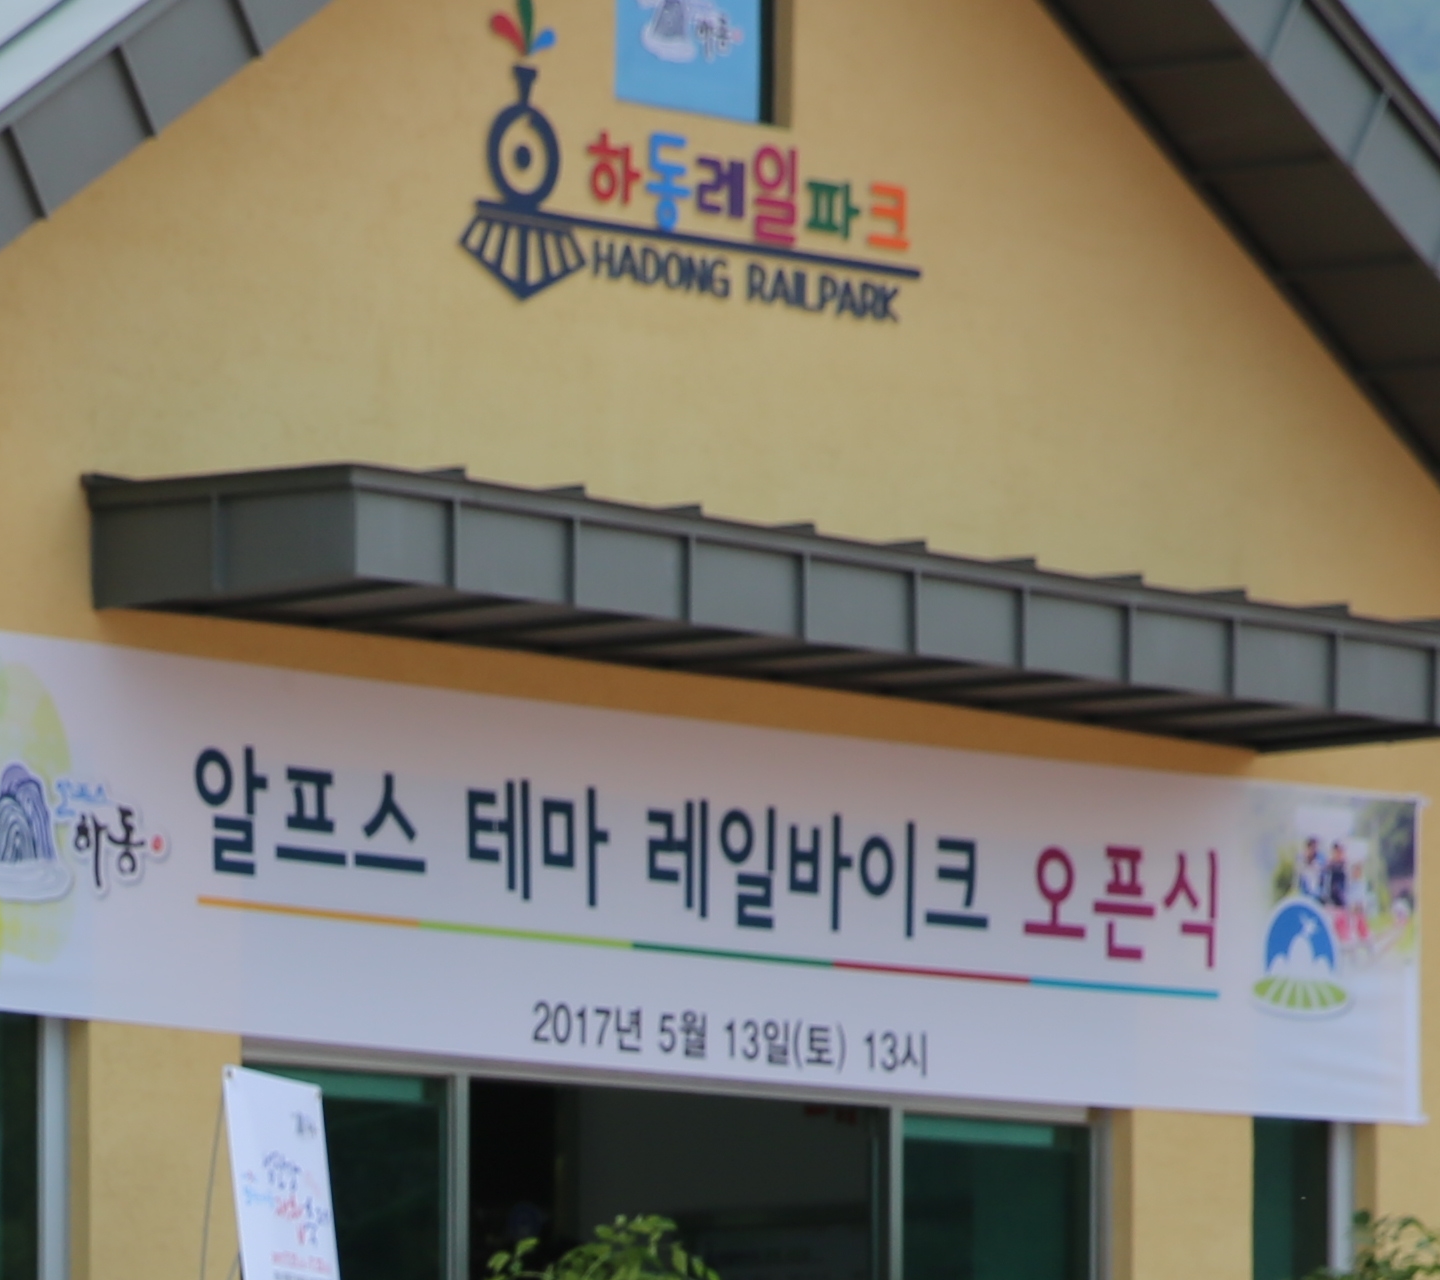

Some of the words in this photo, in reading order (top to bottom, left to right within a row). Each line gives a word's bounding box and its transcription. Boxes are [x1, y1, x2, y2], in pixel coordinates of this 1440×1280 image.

[587, 130, 910, 251] 하동레일파크
[593, 242, 730, 299] HADONG
[746, 262, 901, 323] RAILPARK
[74, 806, 146, 887] 하동
[195, 747, 426, 875] 알프스
[467, 780, 609, 906] 테마
[646, 797, 988, 938] 레일바이크
[1023, 845, 1219, 968] 오픈식
[532, 1001, 643, 1053] 2017년
[657, 1011, 708, 1059] 5월
[724, 1019, 847, 1073] 13일(토)
[864, 1031, 928, 1076] 13시
